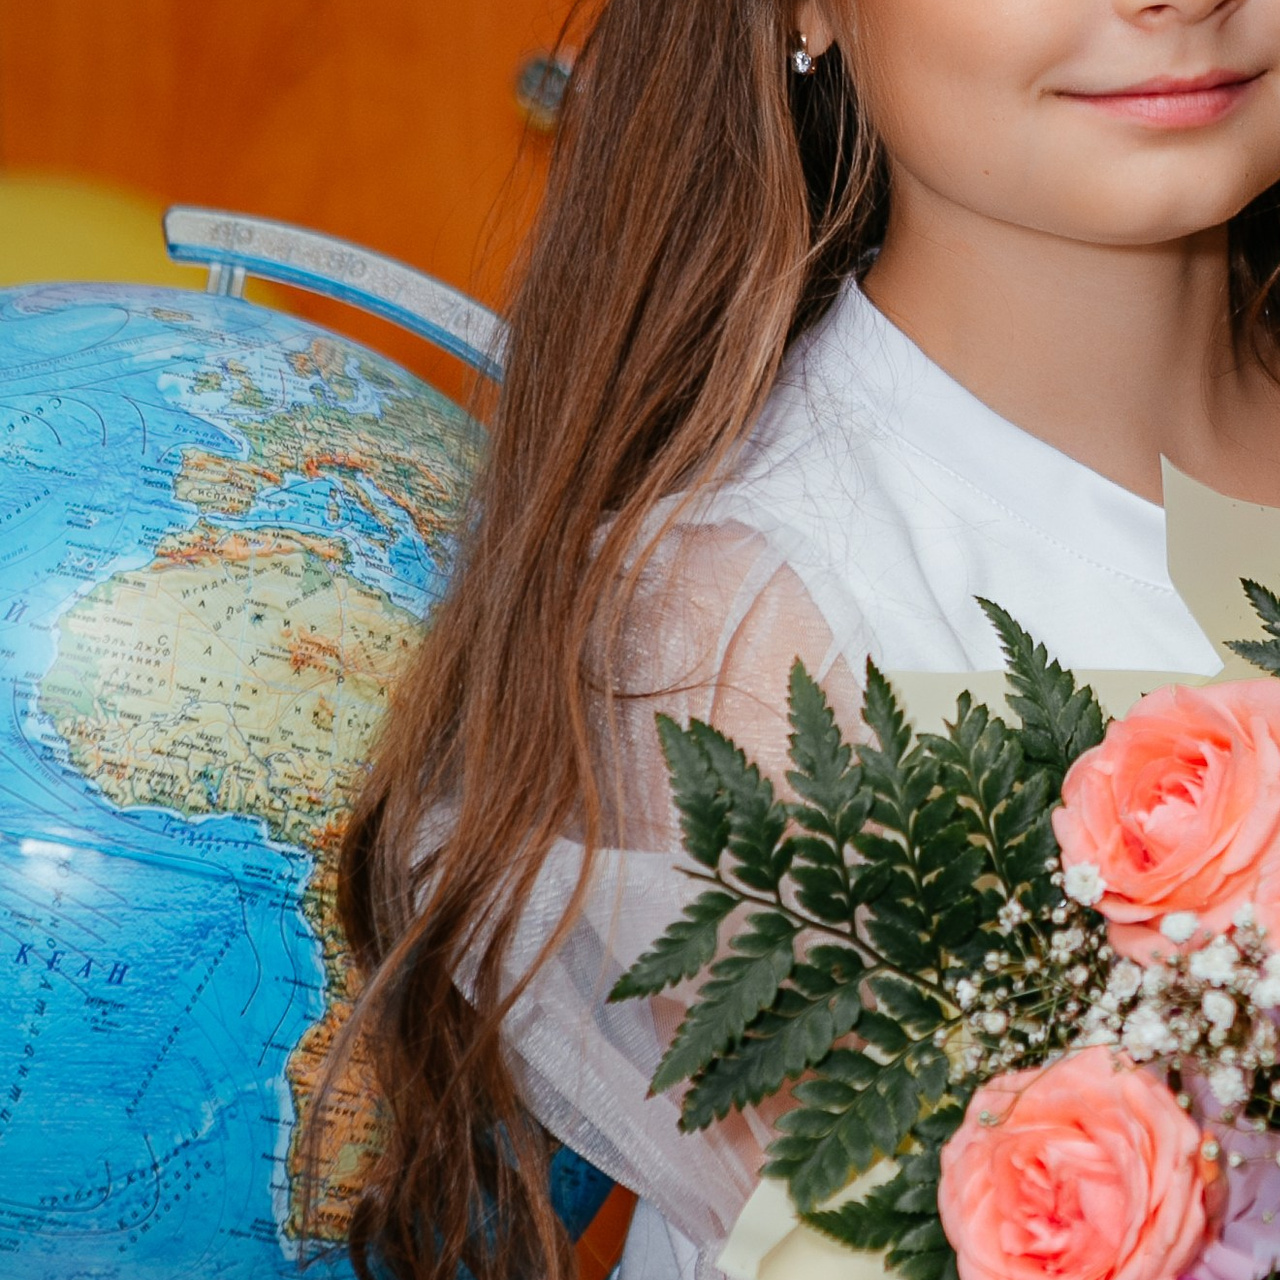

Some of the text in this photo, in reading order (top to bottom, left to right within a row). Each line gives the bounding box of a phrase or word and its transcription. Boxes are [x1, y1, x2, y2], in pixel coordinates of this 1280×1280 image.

[198, 489, 252, 507] ИСПАНИЯ
[181, 577, 229, 599] Игиди
[76, 642, 162, 668] МАВРИТАНИЯ
[158, 634, 386, 698] САХАРА
[199, 676, 258, 696] МАЛИ
[14, 941, 131, 985] КЕАН
